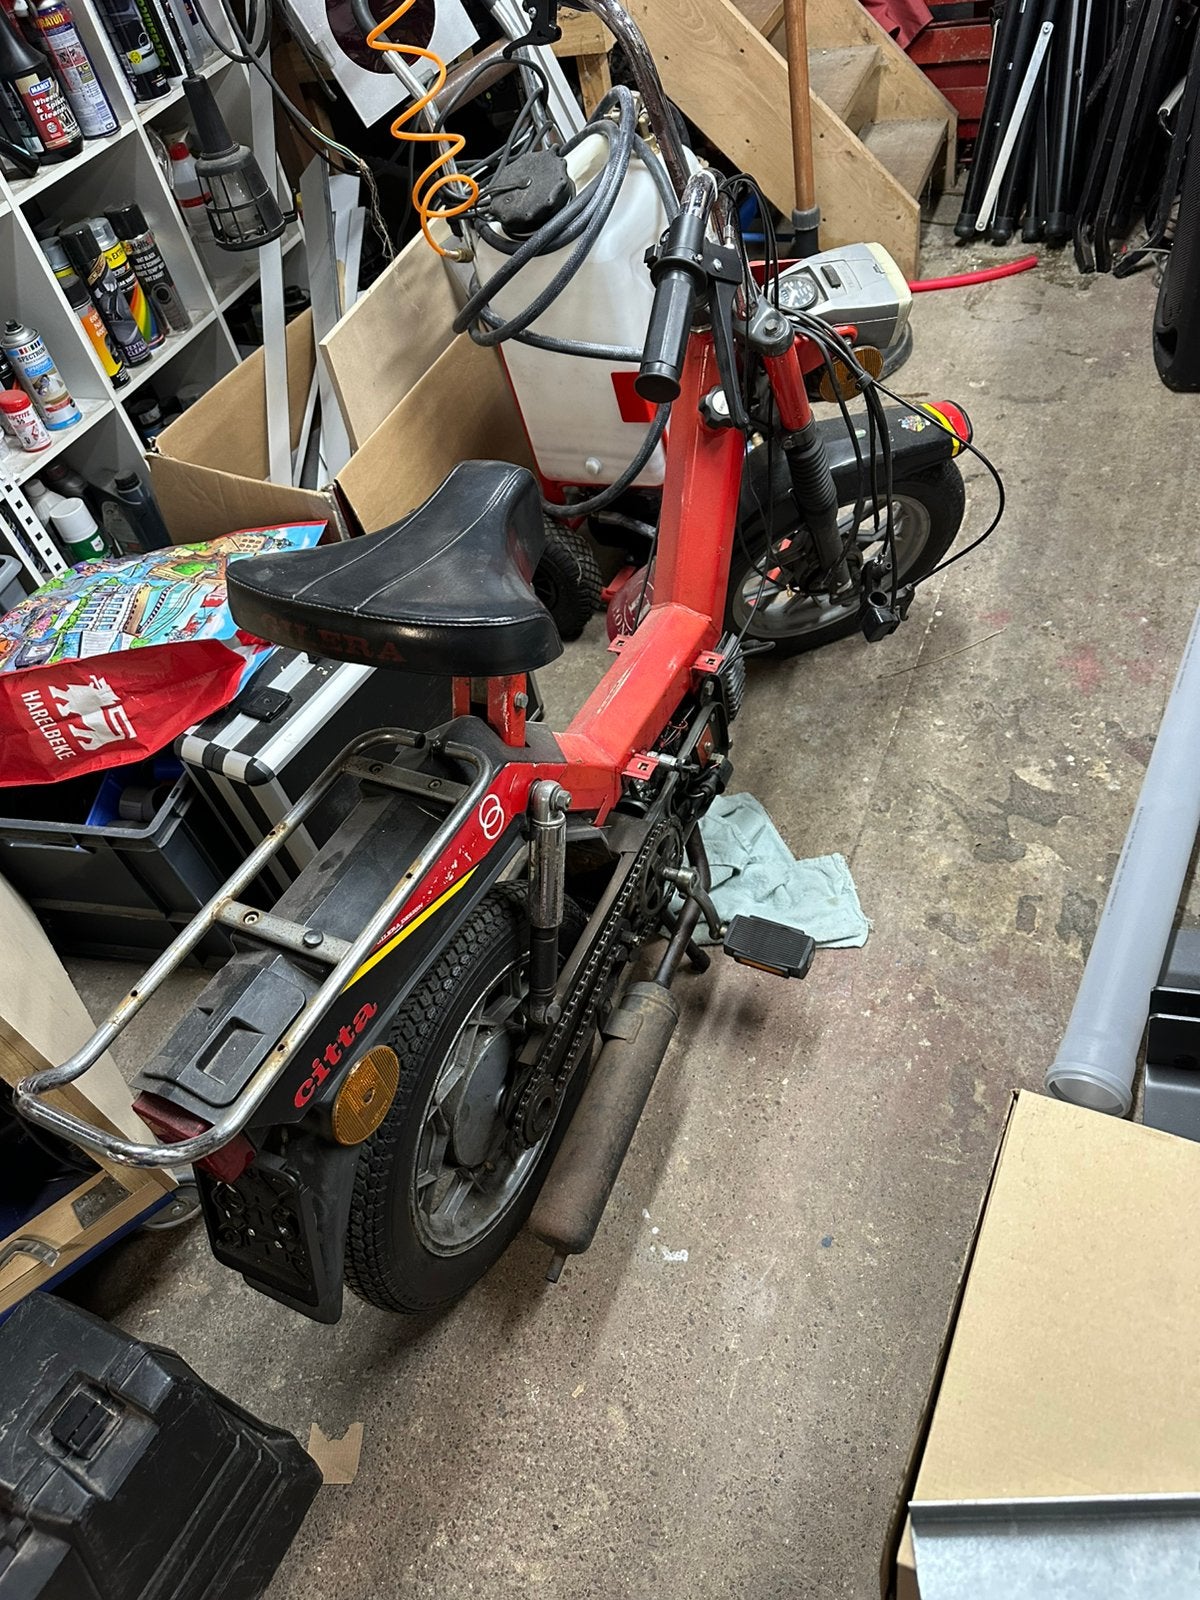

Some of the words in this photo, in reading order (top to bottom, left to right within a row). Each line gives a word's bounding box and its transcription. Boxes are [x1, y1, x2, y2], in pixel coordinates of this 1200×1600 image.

[30, 81, 51, 94] MARLY
[33, 92, 58, 107] Wheels
[36, 106, 43, 114] &
[261, 612, 407, 664] GILERA
[21, 689, 77, 762] HARELBEKE
[294, 999, 378, 1109] citta
